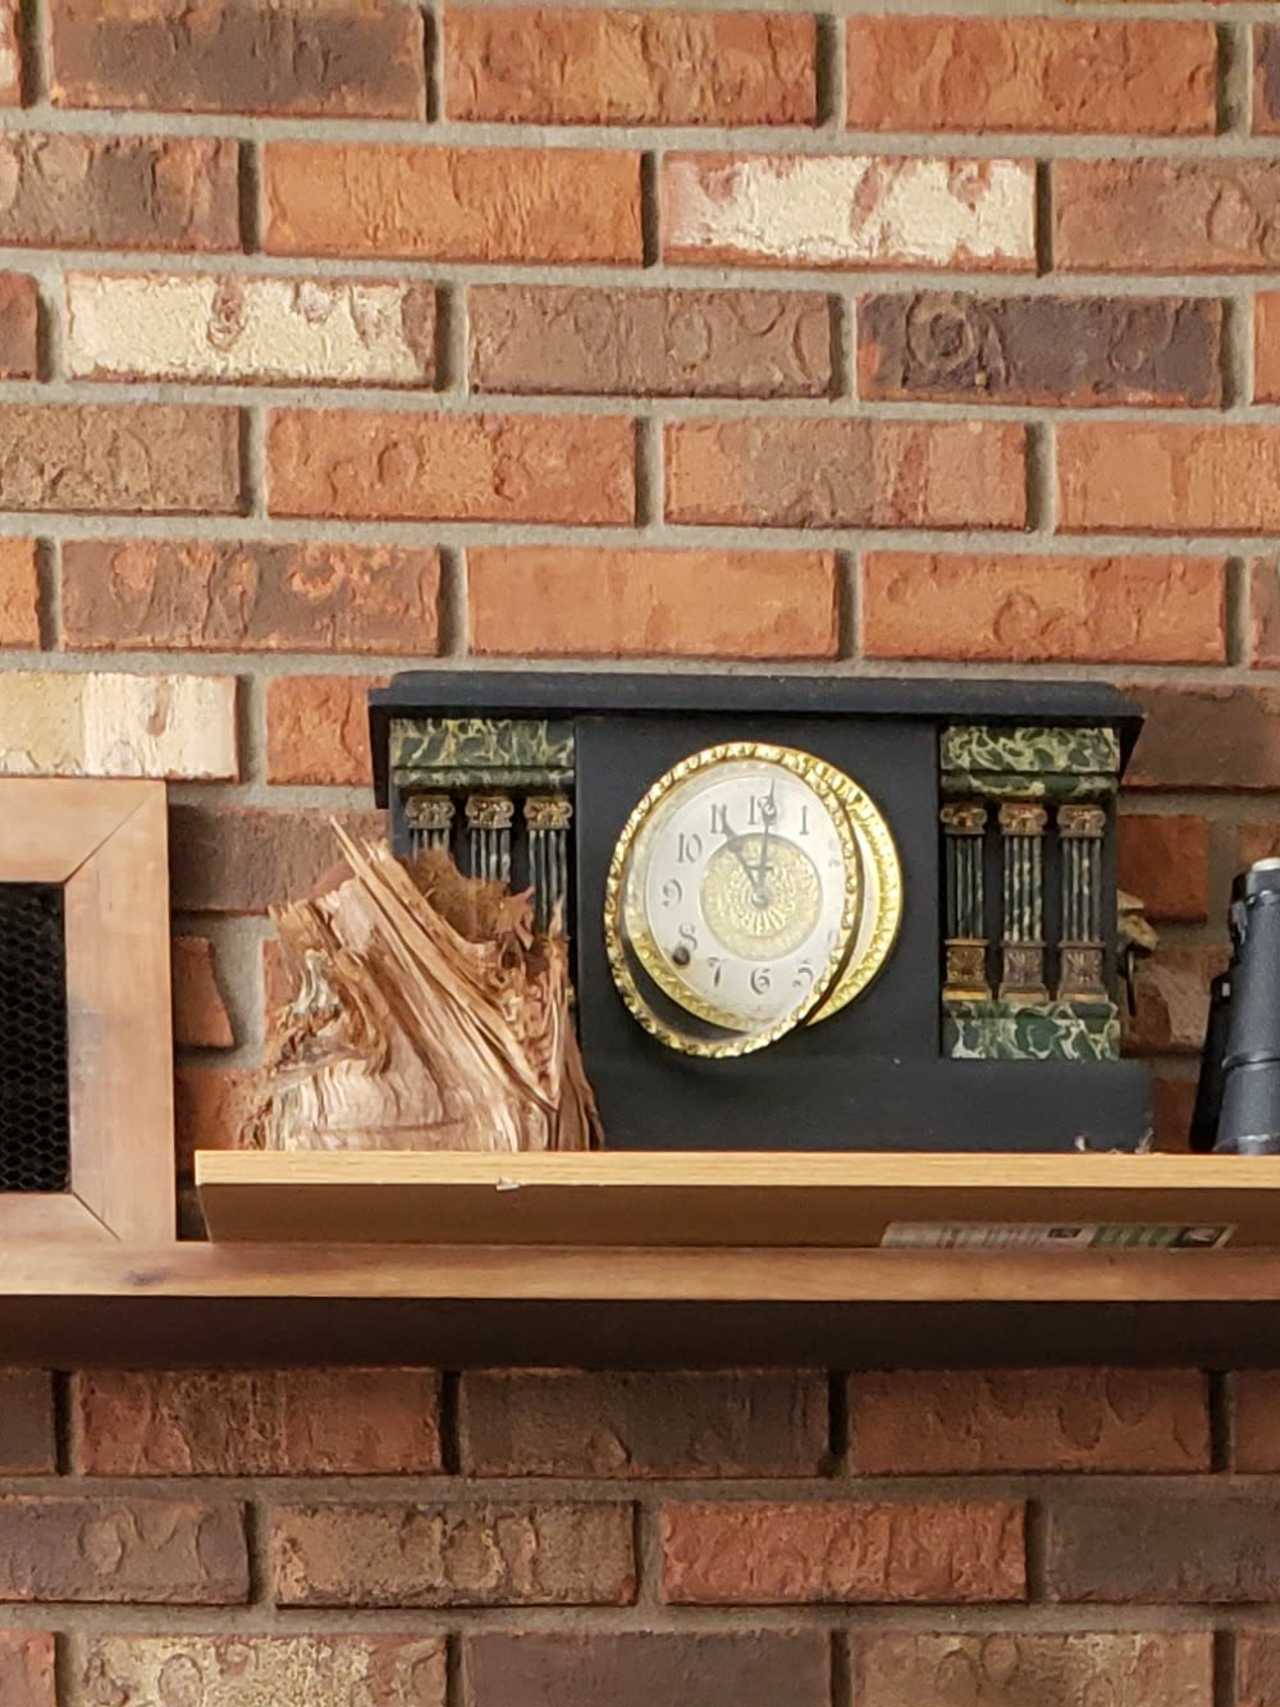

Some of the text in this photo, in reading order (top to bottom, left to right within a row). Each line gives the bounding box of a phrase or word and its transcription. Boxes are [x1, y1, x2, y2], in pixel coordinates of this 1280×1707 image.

[799, 804, 810, 835] 1
[677, 833, 703, 863] 10
[662, 879, 682, 907] 9
[708, 956, 722, 987] 7
[750, 967, 770, 995] 6
